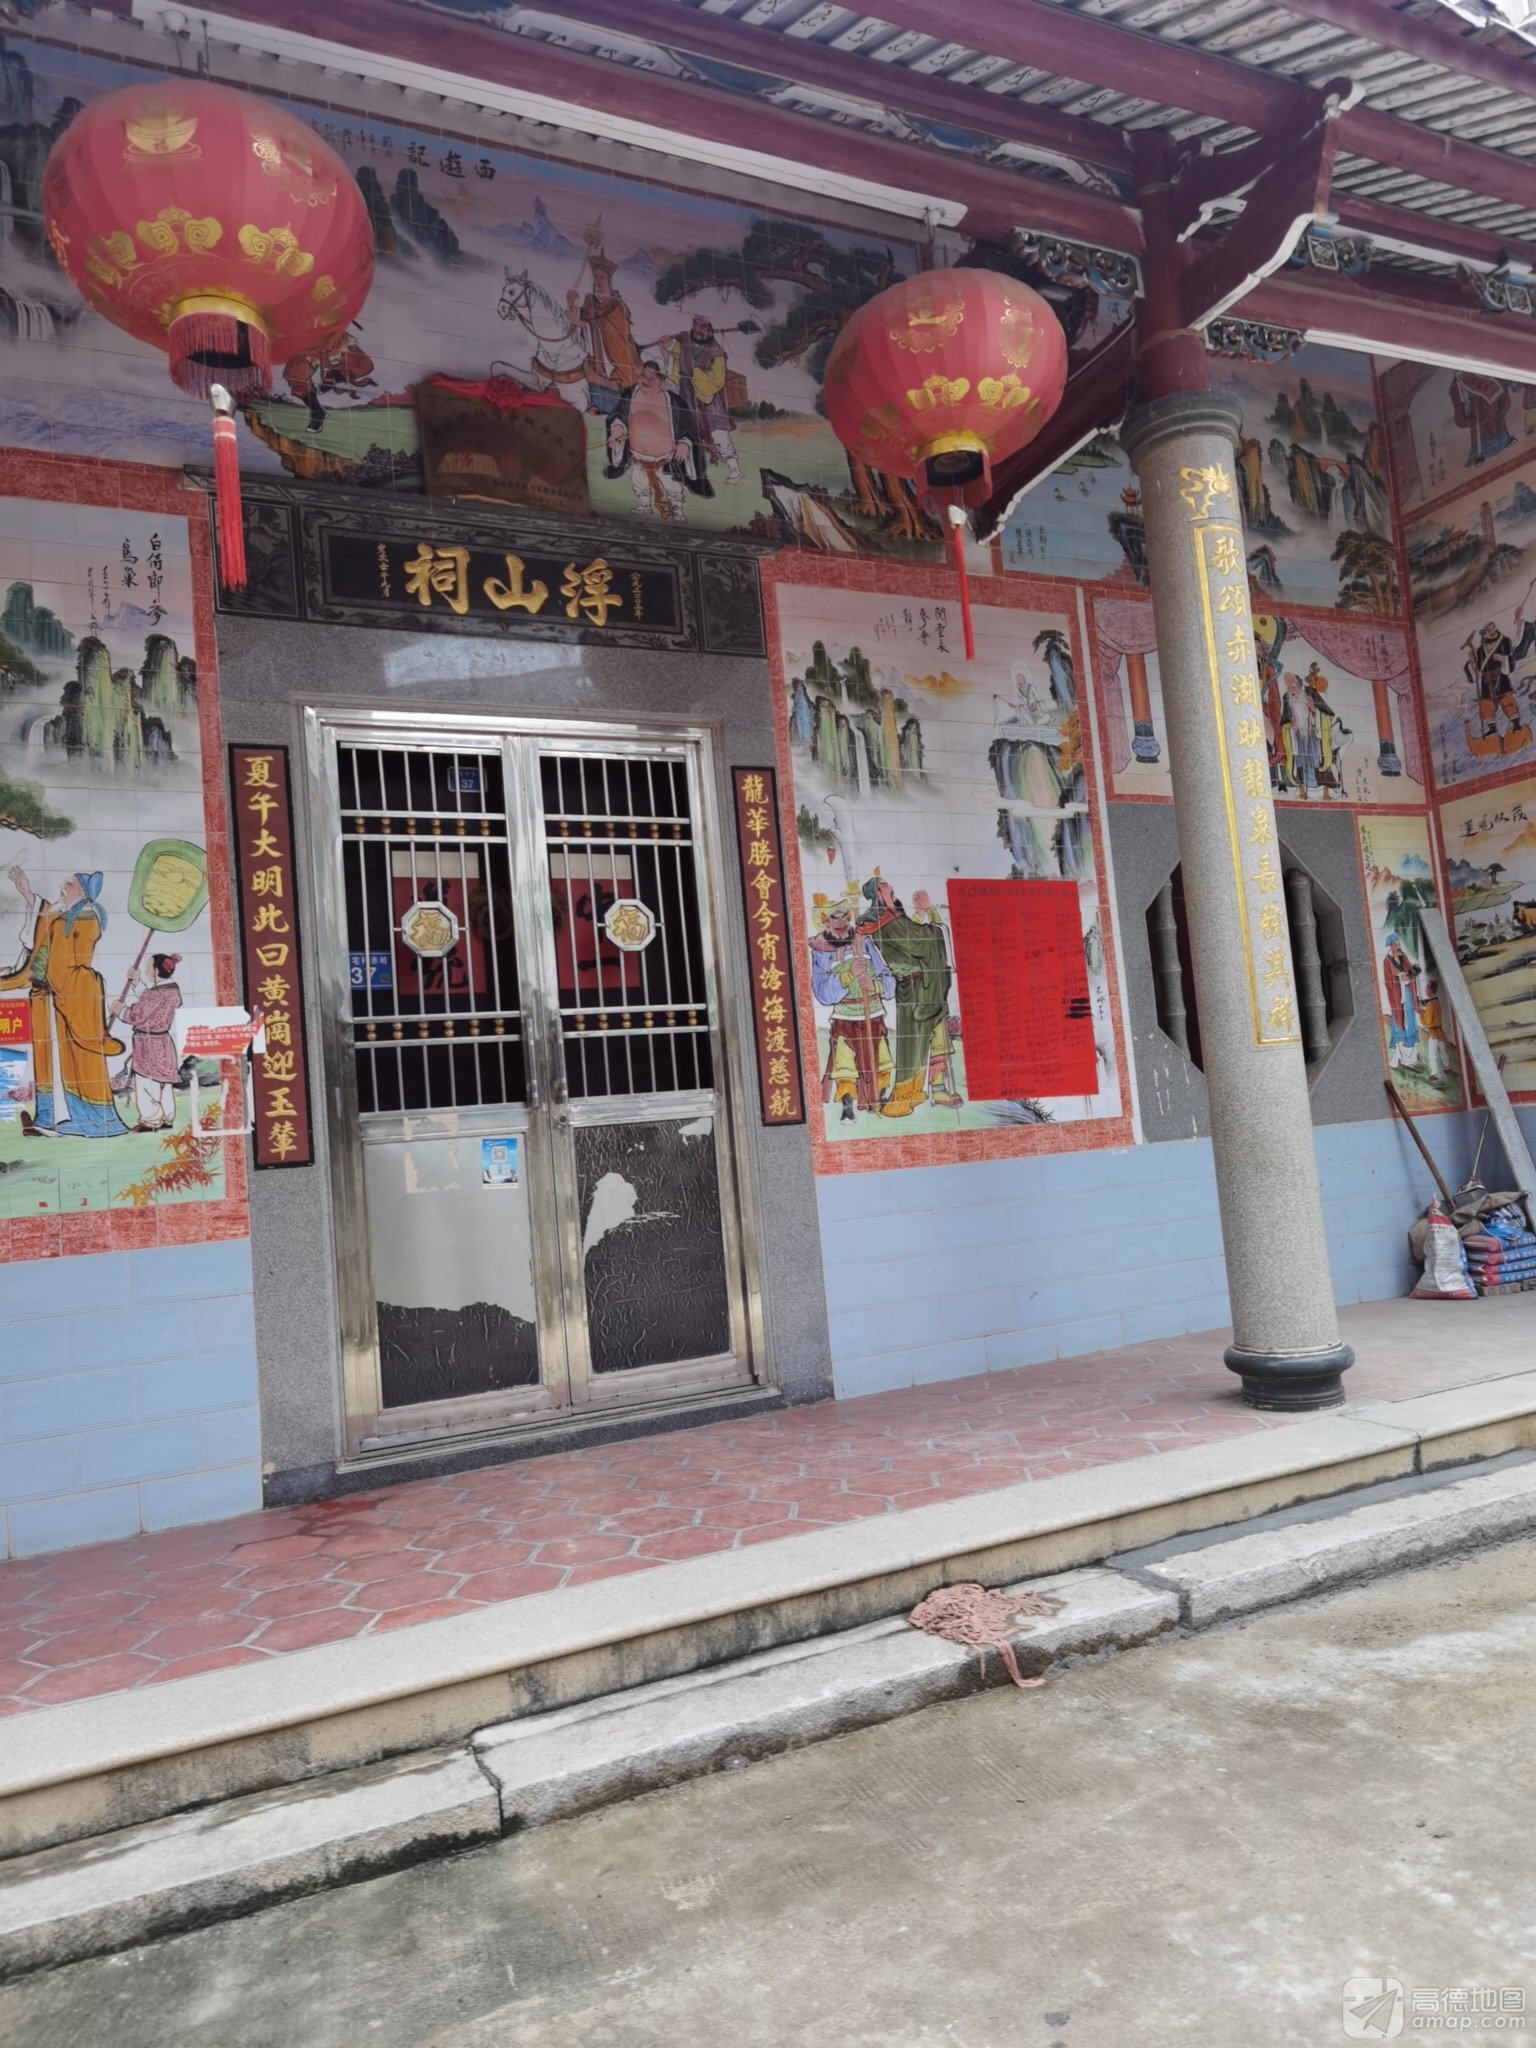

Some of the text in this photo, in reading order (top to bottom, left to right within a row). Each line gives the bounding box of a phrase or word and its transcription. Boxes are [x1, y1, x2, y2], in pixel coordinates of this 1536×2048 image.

[403, 542, 623, 628] 浮山祠
[461, 778, 474, 789] 37
[351, 966, 377, 985] 37
